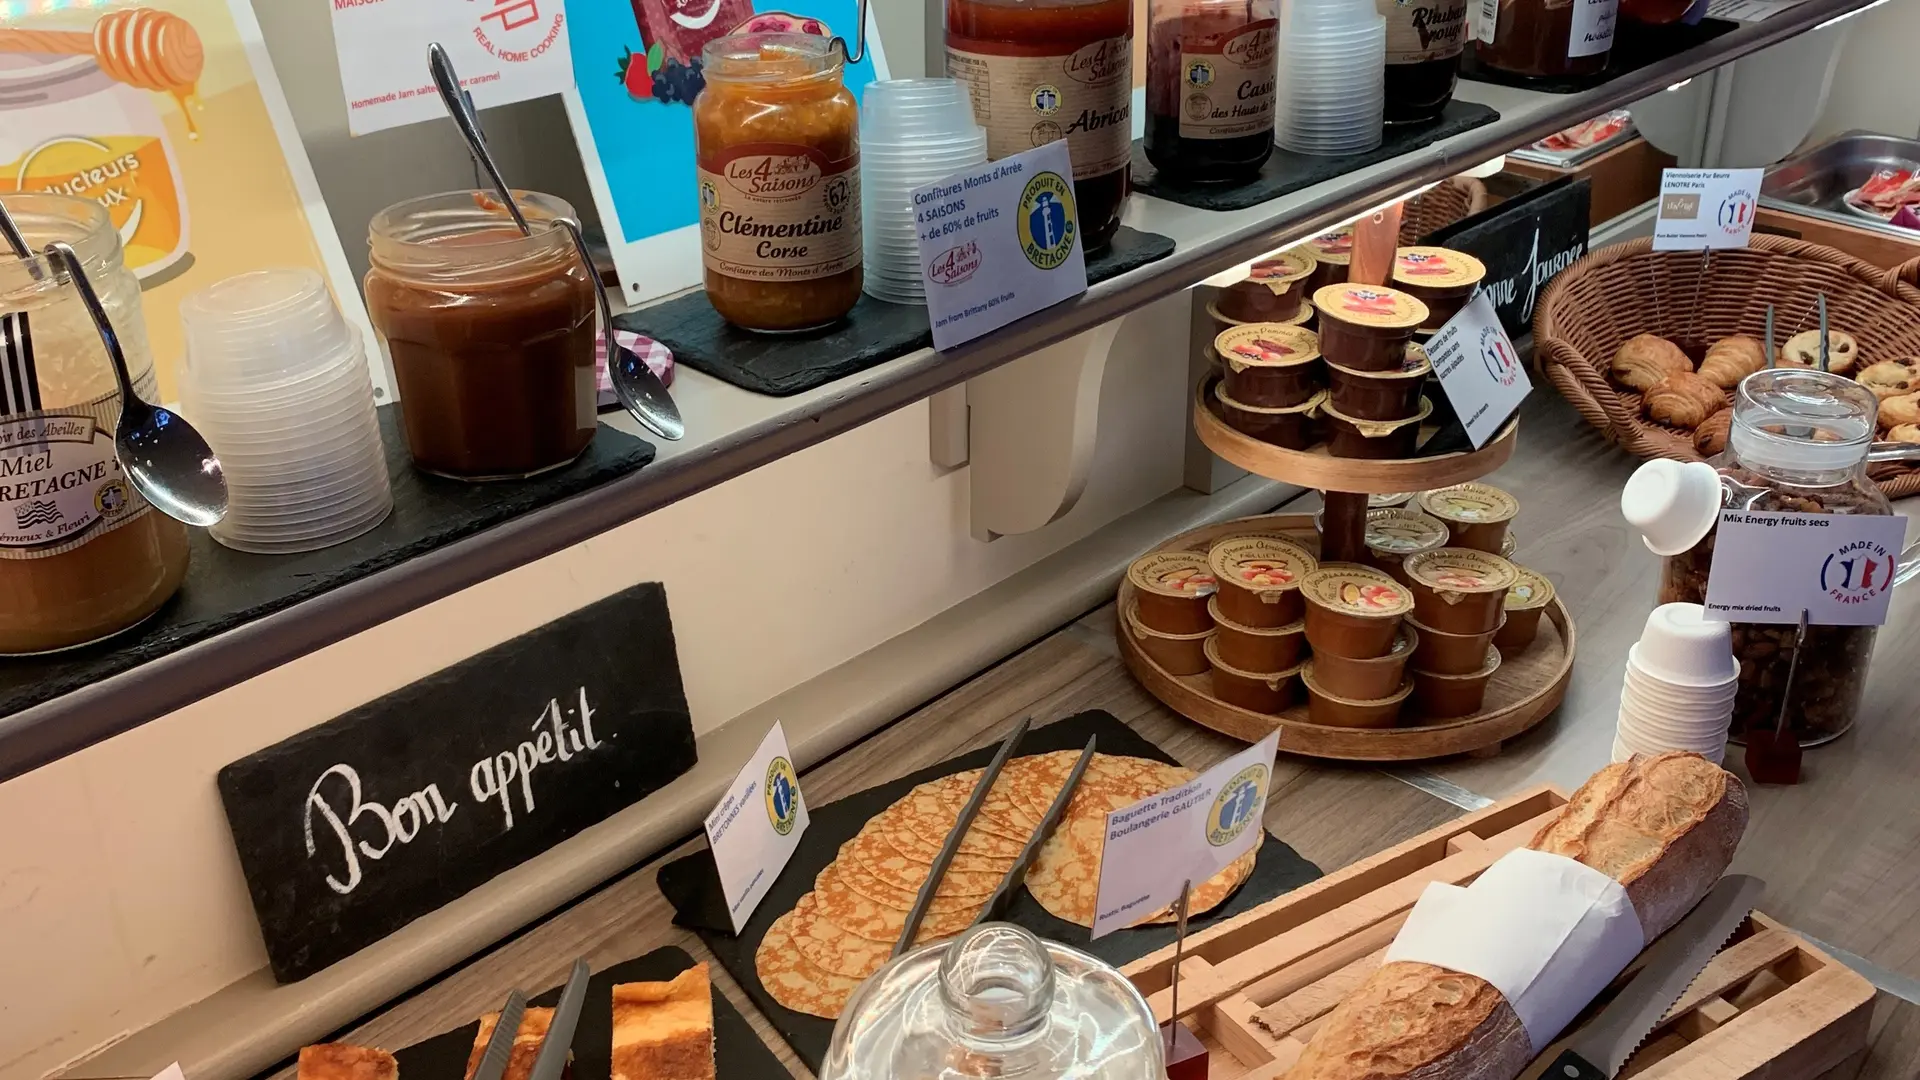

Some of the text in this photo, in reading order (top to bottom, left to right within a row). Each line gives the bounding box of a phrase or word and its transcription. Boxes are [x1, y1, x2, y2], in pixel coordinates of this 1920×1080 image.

[334, 0, 384, 10] MAIS
[1412, 5, 1467, 28] Rhubar
[473, 13, 564, 62] REAL HOME COOKING
[1228, 30, 1262, 55] Les 4
[1071, 41, 1107, 72] Les 4
[470, 71, 501, 86] caramel
[351, 92, 396, 110] Homemade
[398, 89, 415, 100] Jam
[1211, 106, 1229, 120] des
[1231, 102, 1260, 118] Hauts
[1065, 100, 1130, 134] Abricot
[44, 153, 140, 196] ducteurs
[730, 156, 773, 182] Les 4
[1665, 171, 1702, 179] Viennoiserie
[748, 174, 816, 194] Saisons
[914, 162, 1023, 205] Confitures Monts d'Arrée
[1022, 177, 1066, 210] PRODUIT EN
[1727, 188, 1752, 200] MADE IN
[918, 199, 966, 223] 4 SAISONS
[719, 210, 843, 238] Clémentine
[920, 207, 1000, 241] + de 60% de fruits
[756, 240, 809, 259] Corse
[1026, 234, 1073, 267] BRETAGNE
[719, 261, 758, 276] Confiture
[758, 269, 774, 277] des
[775, 266, 811, 277] Monts
[932, 250, 956, 278] Les 4
[944, 259, 979, 284] Saisons
[1469, 277, 1518, 311] onne
[935, 317, 949, 329] Jam
[948, 311, 964, 323] from
[964, 302, 988, 318] Brittany
[1001, 291, 1016, 303] fruits
[1426, 324, 1459, 357] Desserts de fruits
[1450, 340, 1461, 353] sans
[1480, 326, 1494, 347] MADE
[1499, 366, 1517, 388] FRANCE
[0, 421, 85, 443] oir des Abeilles
[0, 449, 53, 478] Miel
[0, 461, 107, 502] RETAGNE
[0, 510, 91, 543] émeux & Fleuri
[1723, 513, 1830, 527] Mix Energy fruits secs
[1838, 540, 1887, 557] MADE IN
[1708, 602, 1730, 612] Energy
[1745, 603, 1763, 612] dried
[1763, 604, 1781, 612] fruits
[1829, 588, 1877, 605] FRANCE
[1109, 787, 1213, 841] Boulangerie GAUTIER
[1111, 781, 1203, 827] Baguette Tradition
[304, 763, 458, 894] Bon
[708, 815, 721, 833] Mini
[712, 806, 741, 845] BRETONNES
